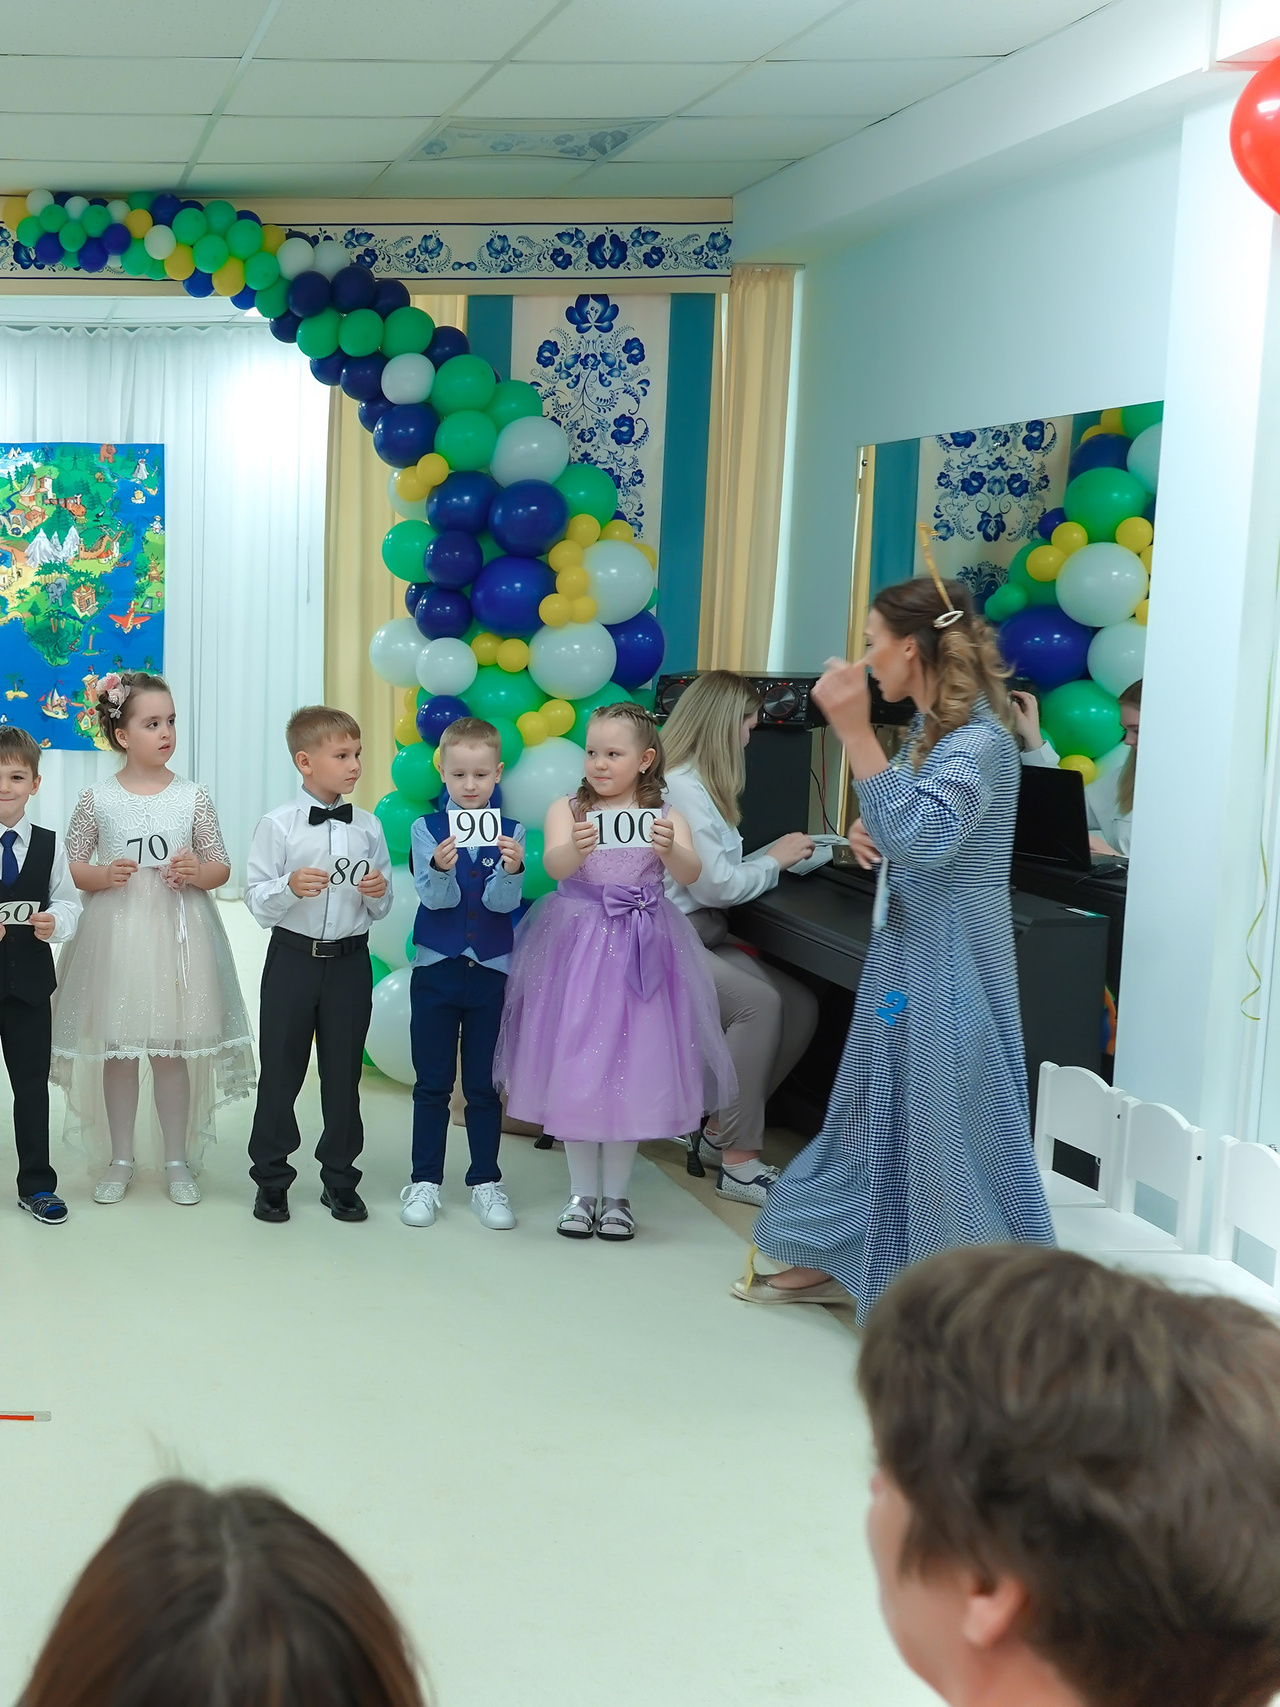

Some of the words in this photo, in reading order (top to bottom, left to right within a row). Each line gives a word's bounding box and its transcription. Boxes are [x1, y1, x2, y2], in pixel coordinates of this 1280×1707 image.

[456, 811, 498, 844] 90
[594, 811, 656, 844] 100
[127, 834, 169, 864] 70
[330, 857, 371, 887] 80
